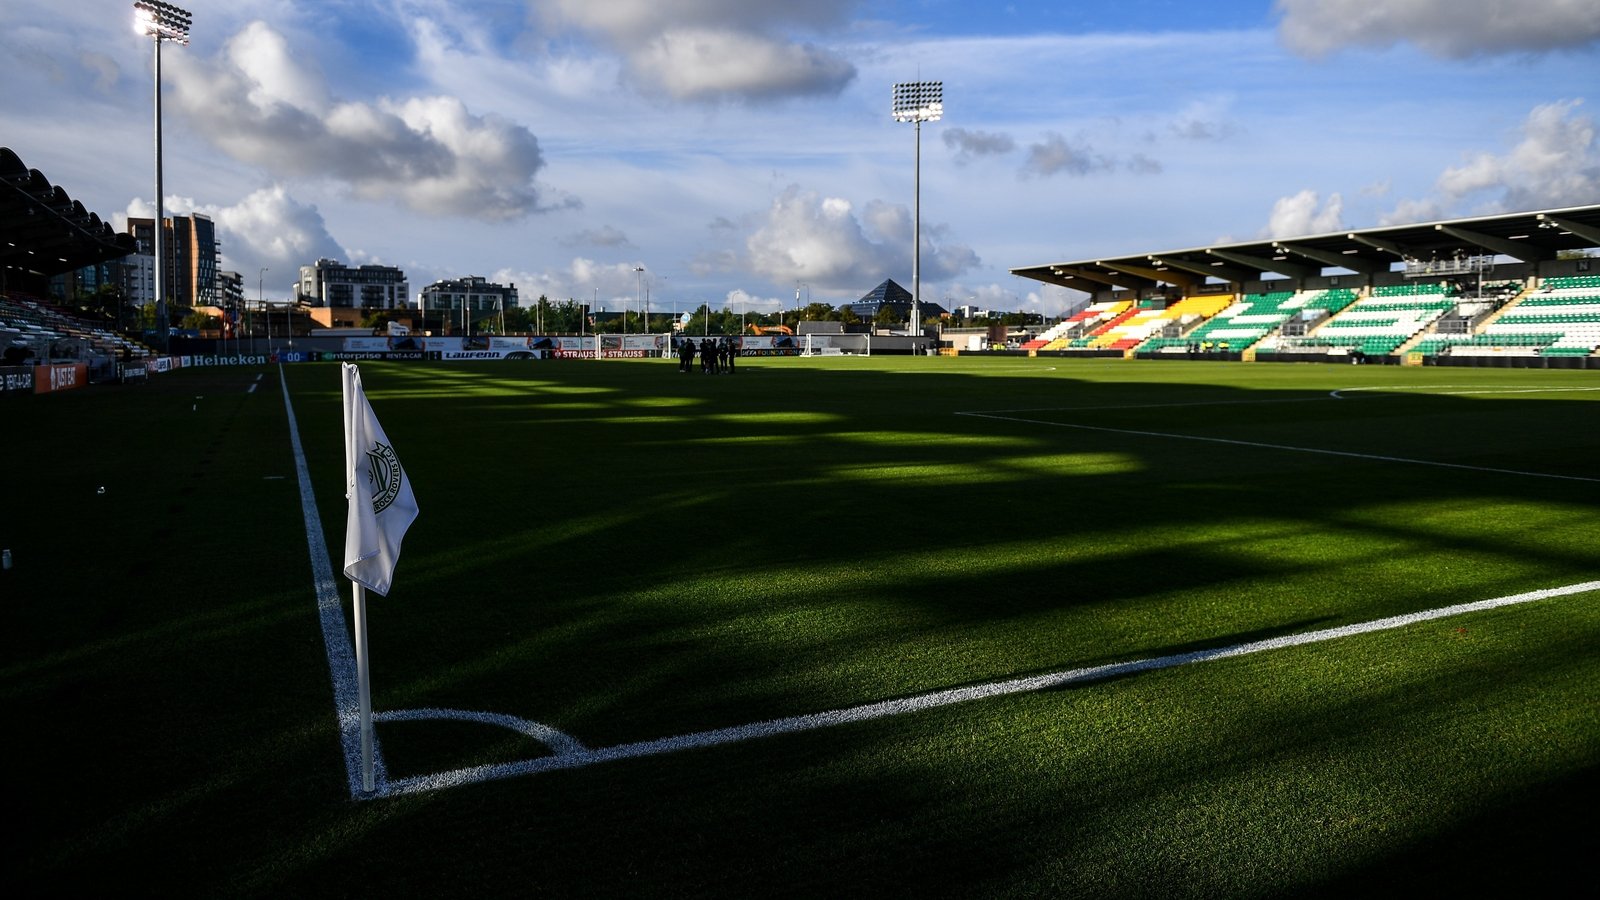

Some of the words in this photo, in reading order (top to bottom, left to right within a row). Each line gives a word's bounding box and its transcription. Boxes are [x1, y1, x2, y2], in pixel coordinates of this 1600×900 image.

[562, 350, 598, 358] STRAUSS
[608, 350, 643, 358] STRAUSS
[193, 354, 266, 366] Heineken
[391, 463, 399, 494] ROVERS
